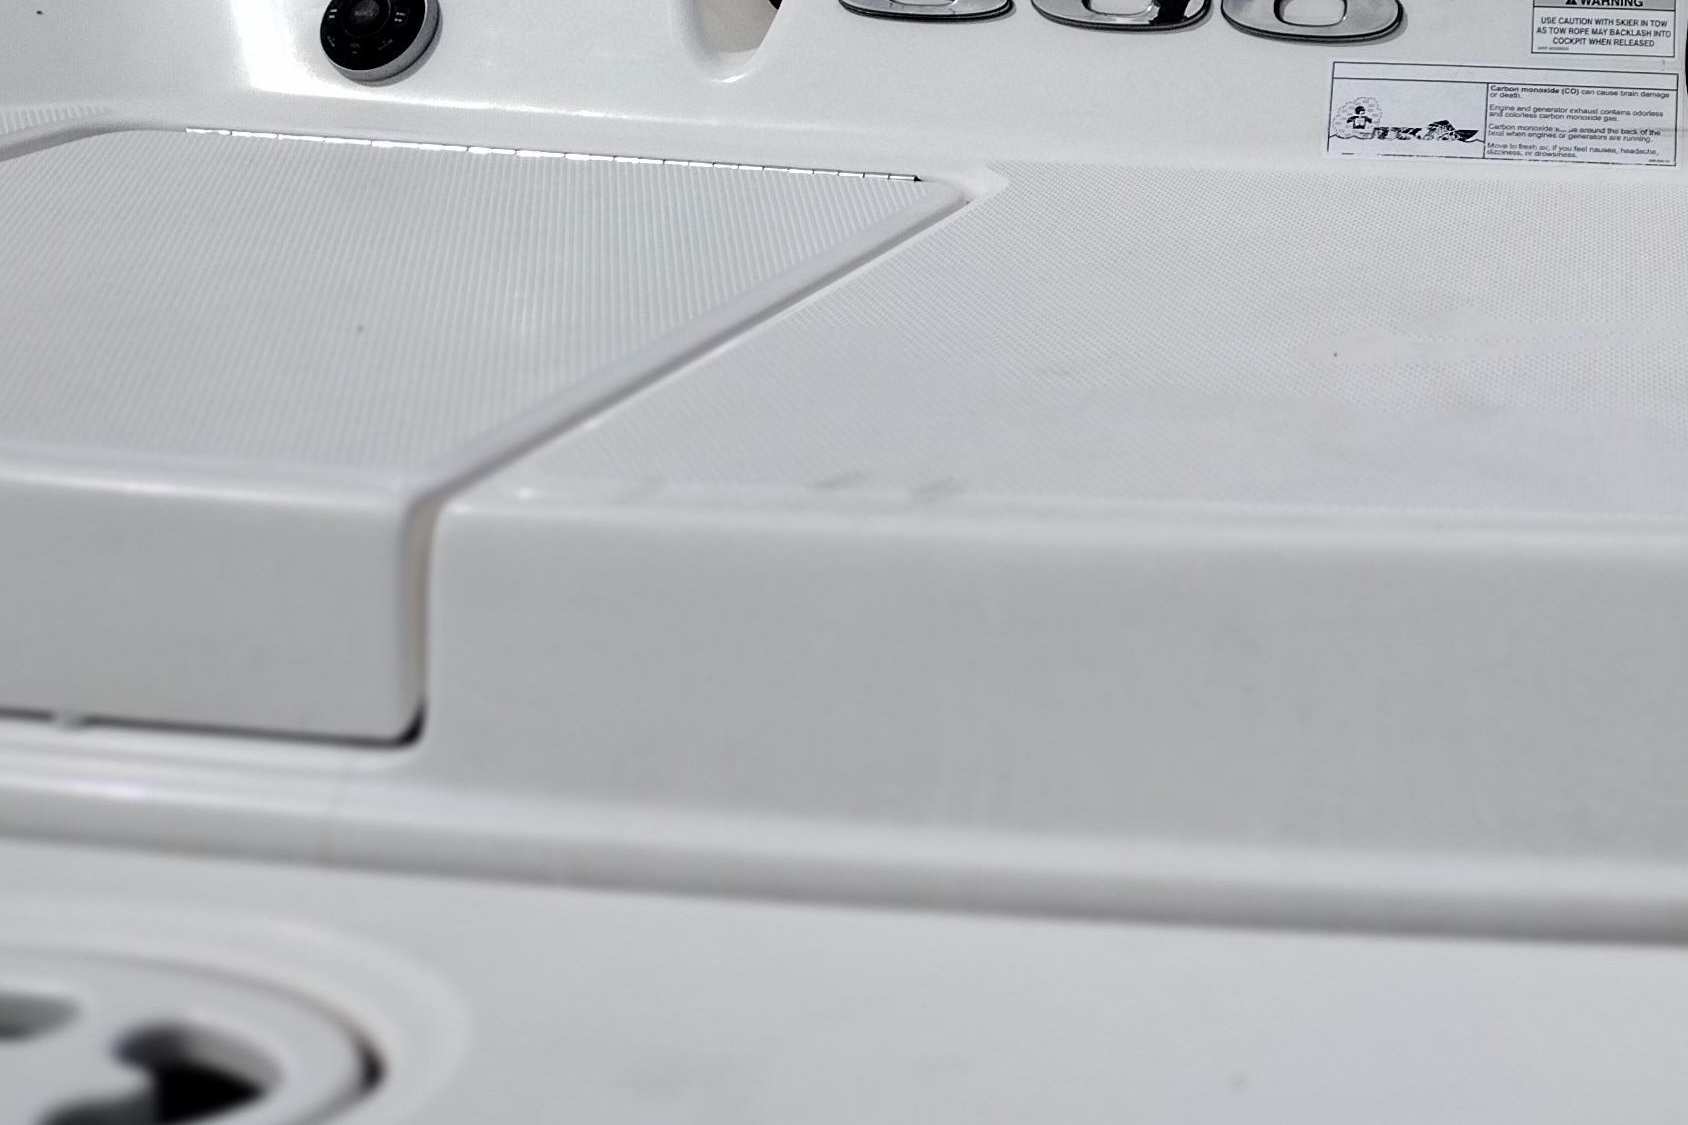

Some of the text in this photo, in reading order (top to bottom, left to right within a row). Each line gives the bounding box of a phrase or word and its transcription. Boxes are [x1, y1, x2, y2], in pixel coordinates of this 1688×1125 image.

[1541, 17, 1557, 25] USE
[1558, 17, 1593, 25] CAUTION
[1594, 18, 1614, 26] WITH
[1615, 19, 1639, 27] SKIER
[1649, 20, 1668, 28] TOW
[1549, 27, 1567, 35] TOW
[1568, 28, 1590, 36] ROPE
[1591, 28, 1608, 36] MAY
[1610, 29, 1652, 37] BACKLASH
[1653, 30, 1672, 38] INTO
[1553, 37, 1655, 47] COCKPIT WHEN RELEASED
[1490, 85, 1519, 93] Carbon
[1561, 88, 1580, 96] (CO)
[1641, 91, 1670, 99] damage
[1489, 104, 1516, 113] Engine
[1533, 106, 1568, 114] generator
[1570, 107, 1599, 115] exhaust
